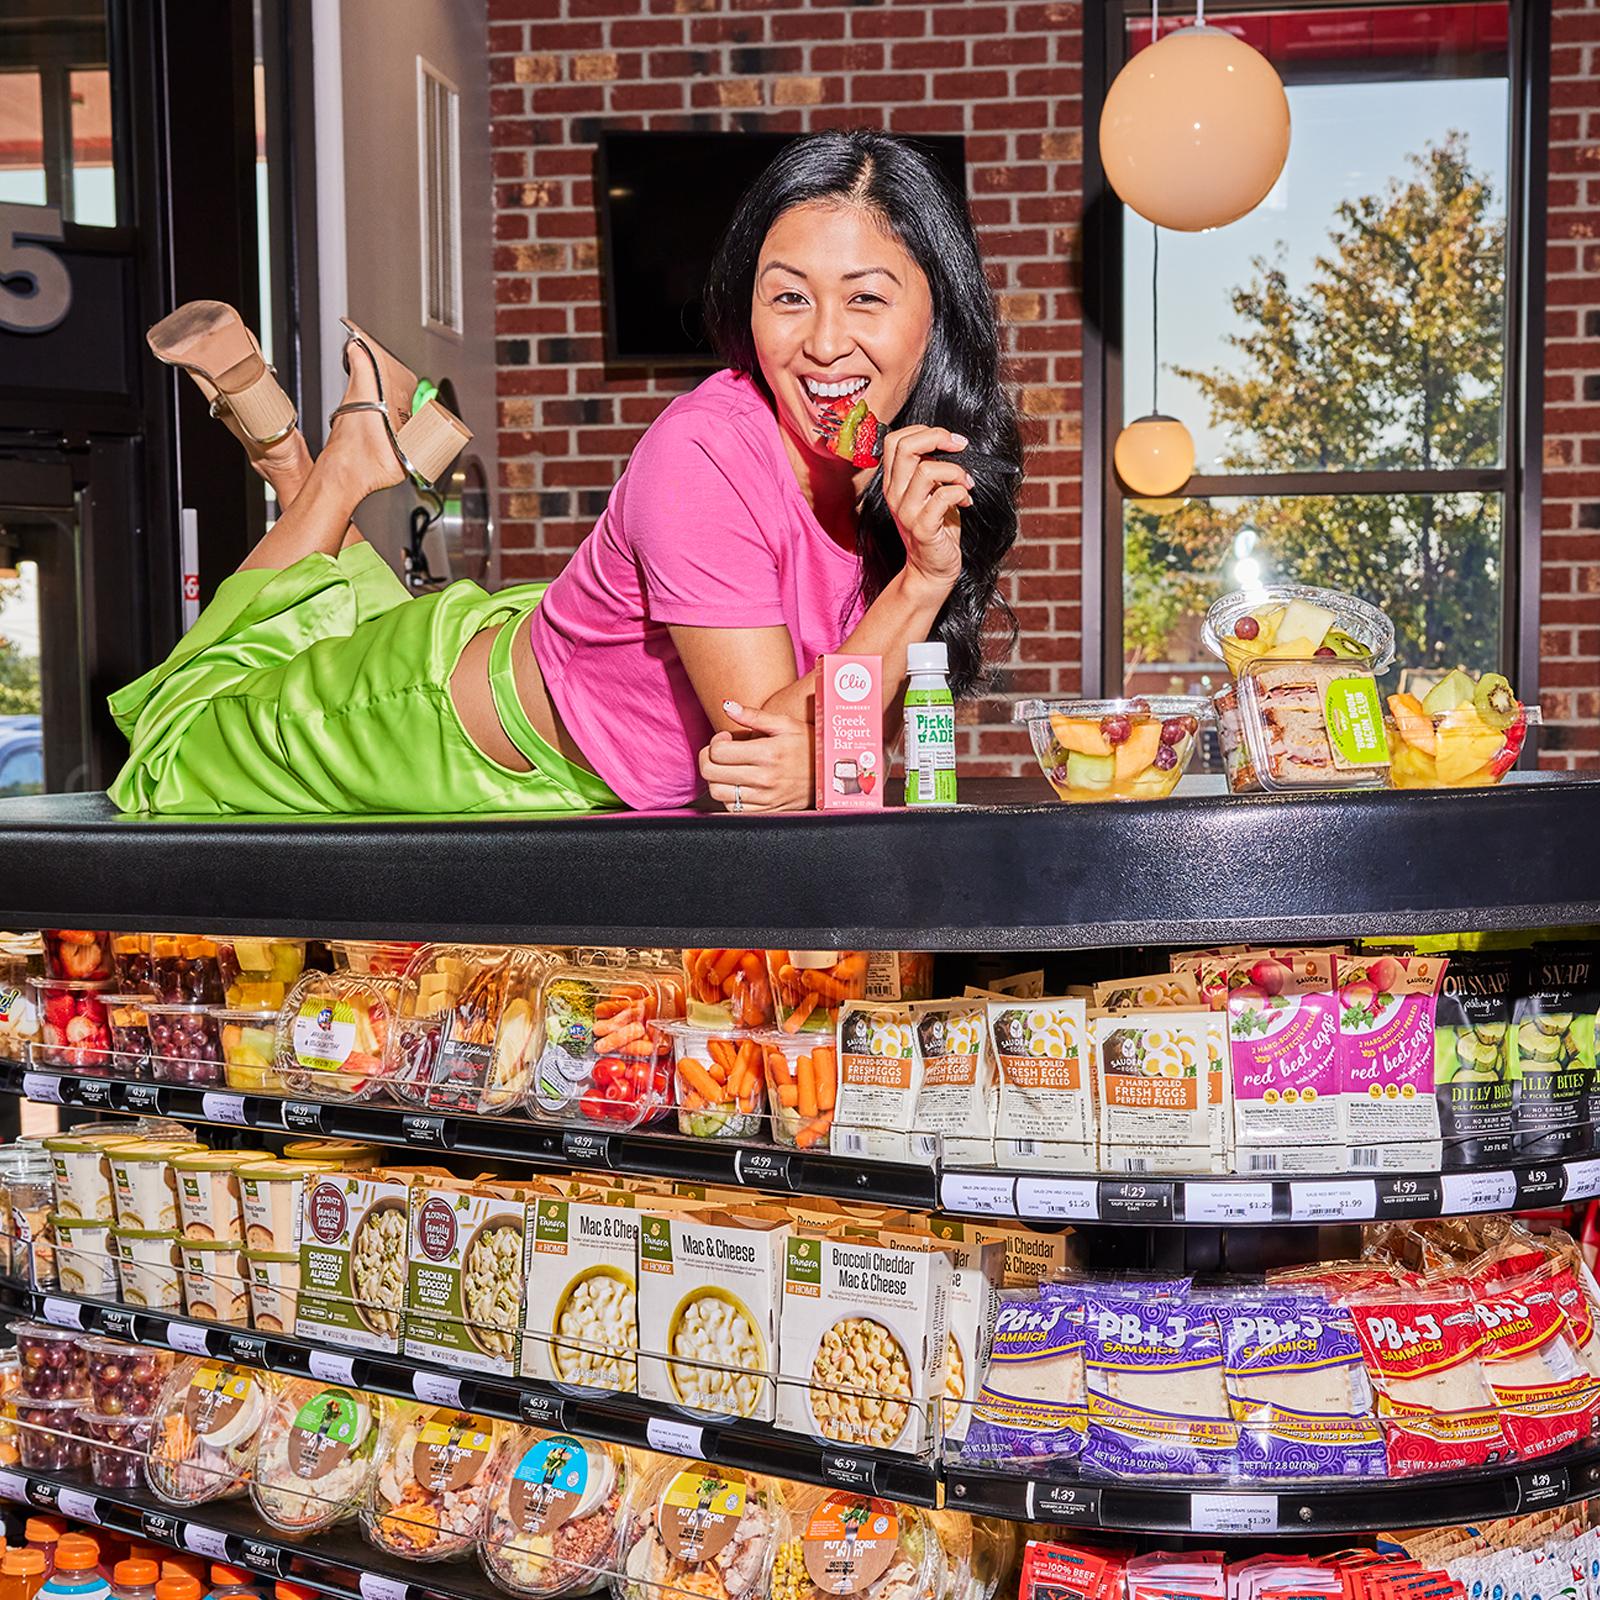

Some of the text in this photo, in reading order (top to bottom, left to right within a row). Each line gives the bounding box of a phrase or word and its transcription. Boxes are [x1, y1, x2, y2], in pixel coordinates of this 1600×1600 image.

[186, 577, 199, 598] 6
[839, 673, 866, 690] Clio
[832, 715, 866, 726] Greek
[916, 715, 952, 729] Pickle
[833, 727, 871, 740] Yogurt
[834, 739, 853, 750] Bar
[1542, 964, 1590, 985] SNAP!
[1443, 973, 1510, 997] OH SNAP!
[1403, 1004, 1418, 1030] PEELED
[1257, 1022, 1300, 1053] HARD-BOILED
[1364, 1019, 1401, 1047] HARD-BOILED
[1244, 1013, 1337, 1086] red beet eggs
[1351, 1012, 1430, 1079] red beet eggs
[1014, 1060, 1065, 1068] HARD-BOILED
[848, 1066, 902, 1076] FRESH EGGS
[1007, 1068, 1069, 1078] FRESH EGGS
[1040, 1078, 1070, 1086] PEELED
[1125, 1080, 1182, 1088] HARD-BOILED
[1557, 1074, 1584, 1088] BITES
[1115, 1087, 1186, 1098] FRESH EGGS
[1452, 1087, 1490, 1102] DILLY
[1116, 1097, 1186, 1106] PERFECT PEELED
[539, 1218, 566, 1228] Panera
[580, 1216, 601, 1235] Mac
[604, 1218, 612, 1235] &
[643, 1234, 669, 1247] Panera
[544, 1244, 566, 1254] HOME
[682, 1235, 755, 1262] Mac & Cheese
[1015, 1238, 1054, 1258] Cheddar
[309, 1253, 336, 1263] CHICKEN
[789, 1254, 819, 1268] Panera
[833, 1248, 915, 1275] Broccoli Cheddar
[1013, 1253, 1047, 1276] Cheese
[309, 1261, 342, 1273] BROCCOLI
[649, 1263, 671, 1273] HOME
[310, 1270, 339, 1280] ALFREDO
[417, 1270, 445, 1281] CHICKEN
[418, 1278, 451, 1291] BROCCOLI
[839, 1270, 906, 1295] Mac & Cheese
[418, 1288, 449, 1299] ALFREDO
[795, 1285, 819, 1296] HOME
[1098, 1312, 1187, 1348] PB+J
[1233, 1317, 1323, 1345] PB+J
[1370, 1314, 1444, 1350] PB+J
[1104, 1342, 1179, 1354] SAMMICH
[1243, 1339, 1317, 1359] SAMMICH
[1381, 1340, 1443, 1362] SAMMICH
[1209, 1423, 1233, 1435] JELLY
[1243, 1461, 1257, 1470] NET
[1275, 1462, 1287, 1470] 2.8
[705, 1512, 726, 1523] FORK
[824, 1541, 839, 1549] PUT
[854, 1540, 876, 1549] FORK
[1048, 1562, 1095, 1579] 100% BEEF
